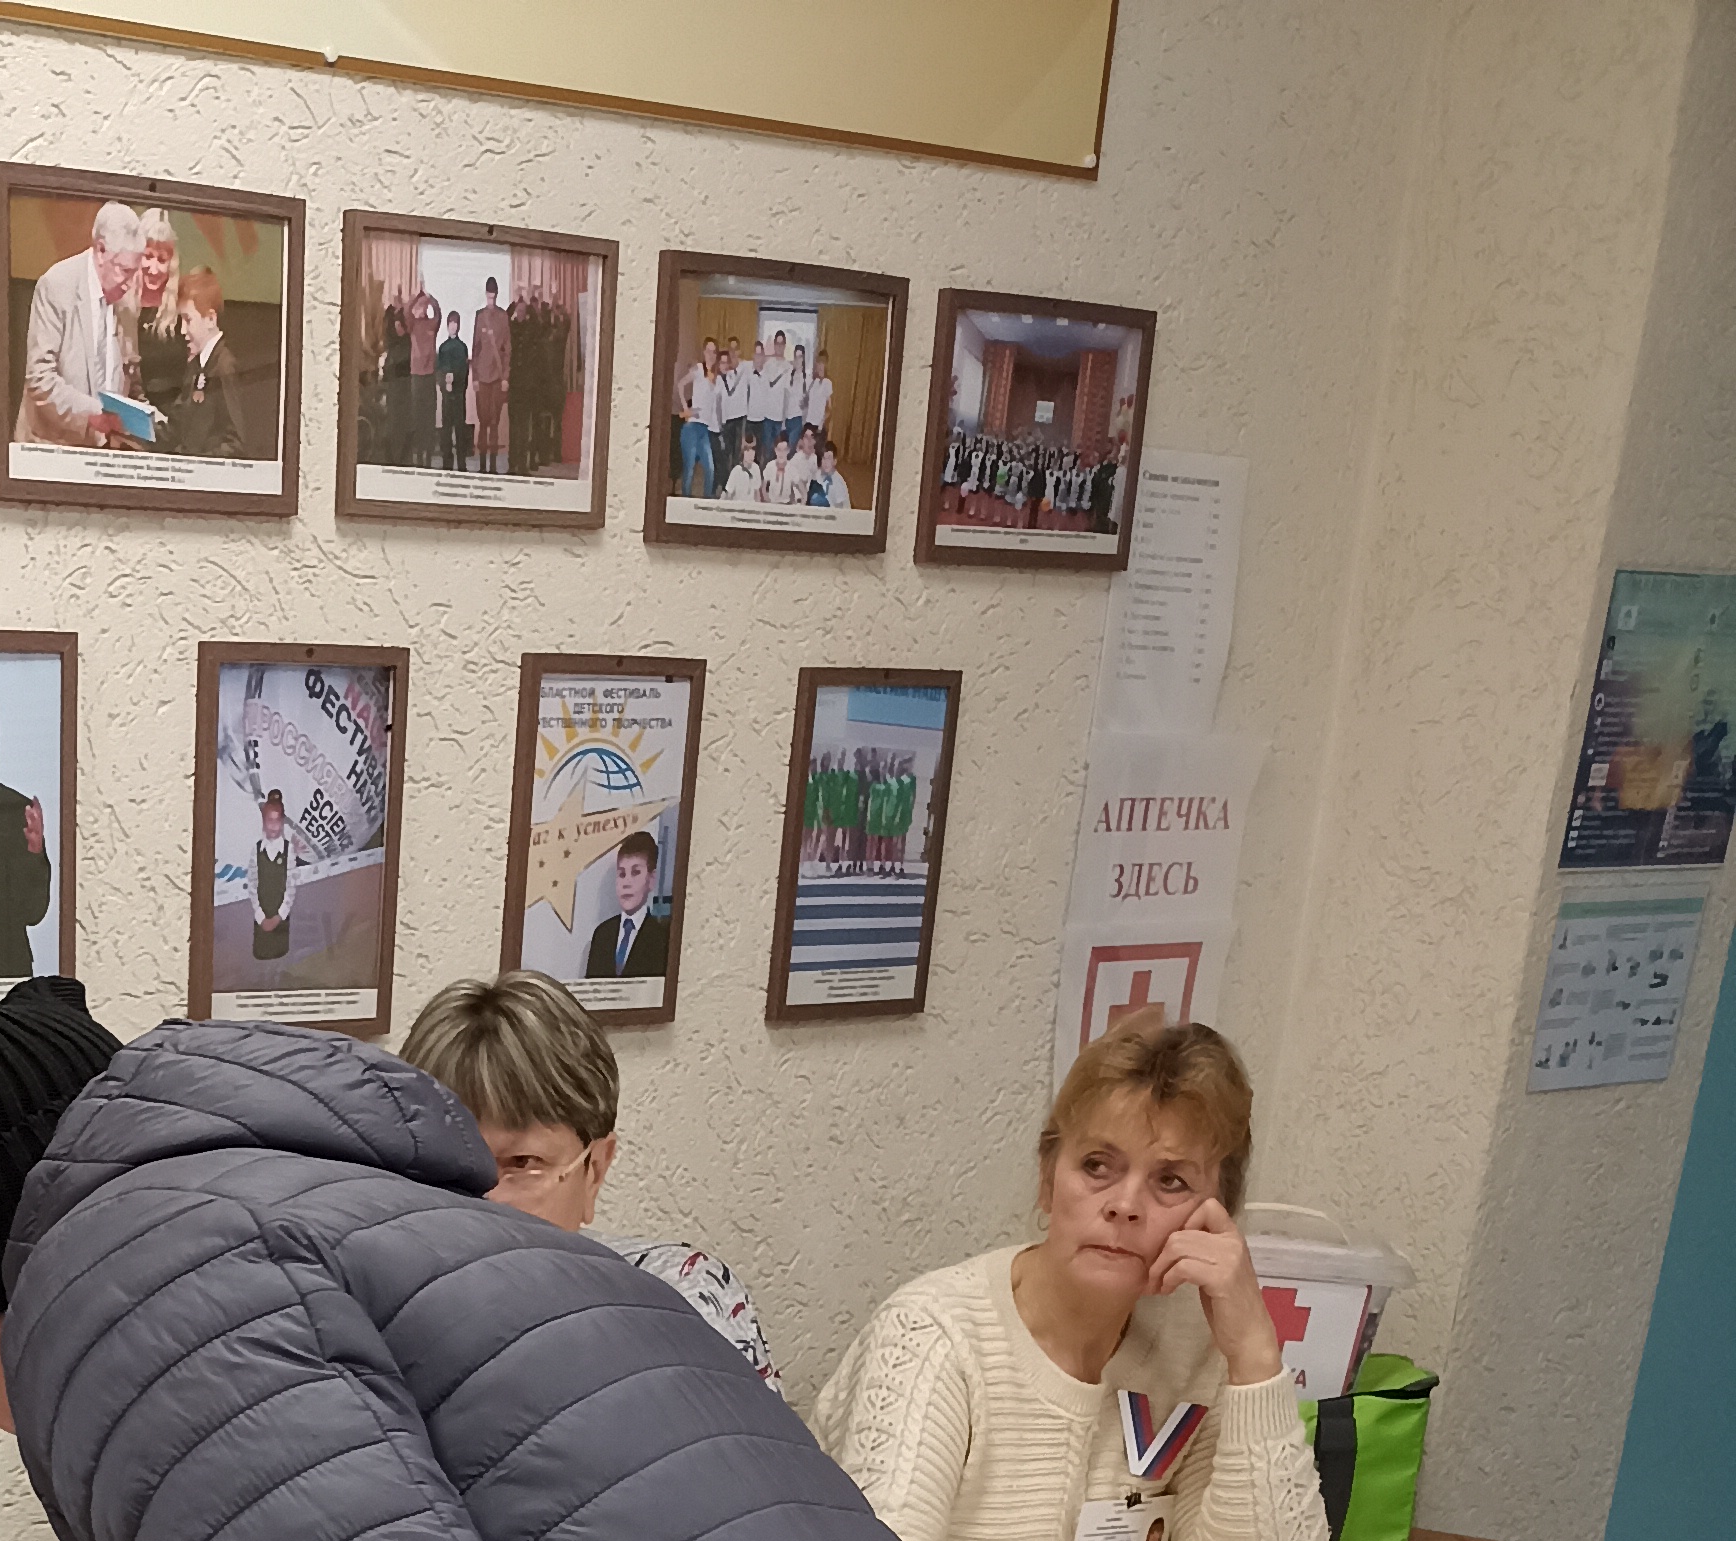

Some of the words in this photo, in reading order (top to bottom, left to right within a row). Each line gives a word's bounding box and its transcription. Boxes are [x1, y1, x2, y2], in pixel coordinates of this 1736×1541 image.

[603, 686, 662, 699] ФЕСТИВАЛЬ
[573, 702, 625, 715] ДЕТСКОГО
[612, 717, 673, 729] ТВОРЧЕСТВА
[1093, 796, 1230, 833] АПТЕЧКА
[1109, 861, 1200, 902] ЗДЕСЬ
